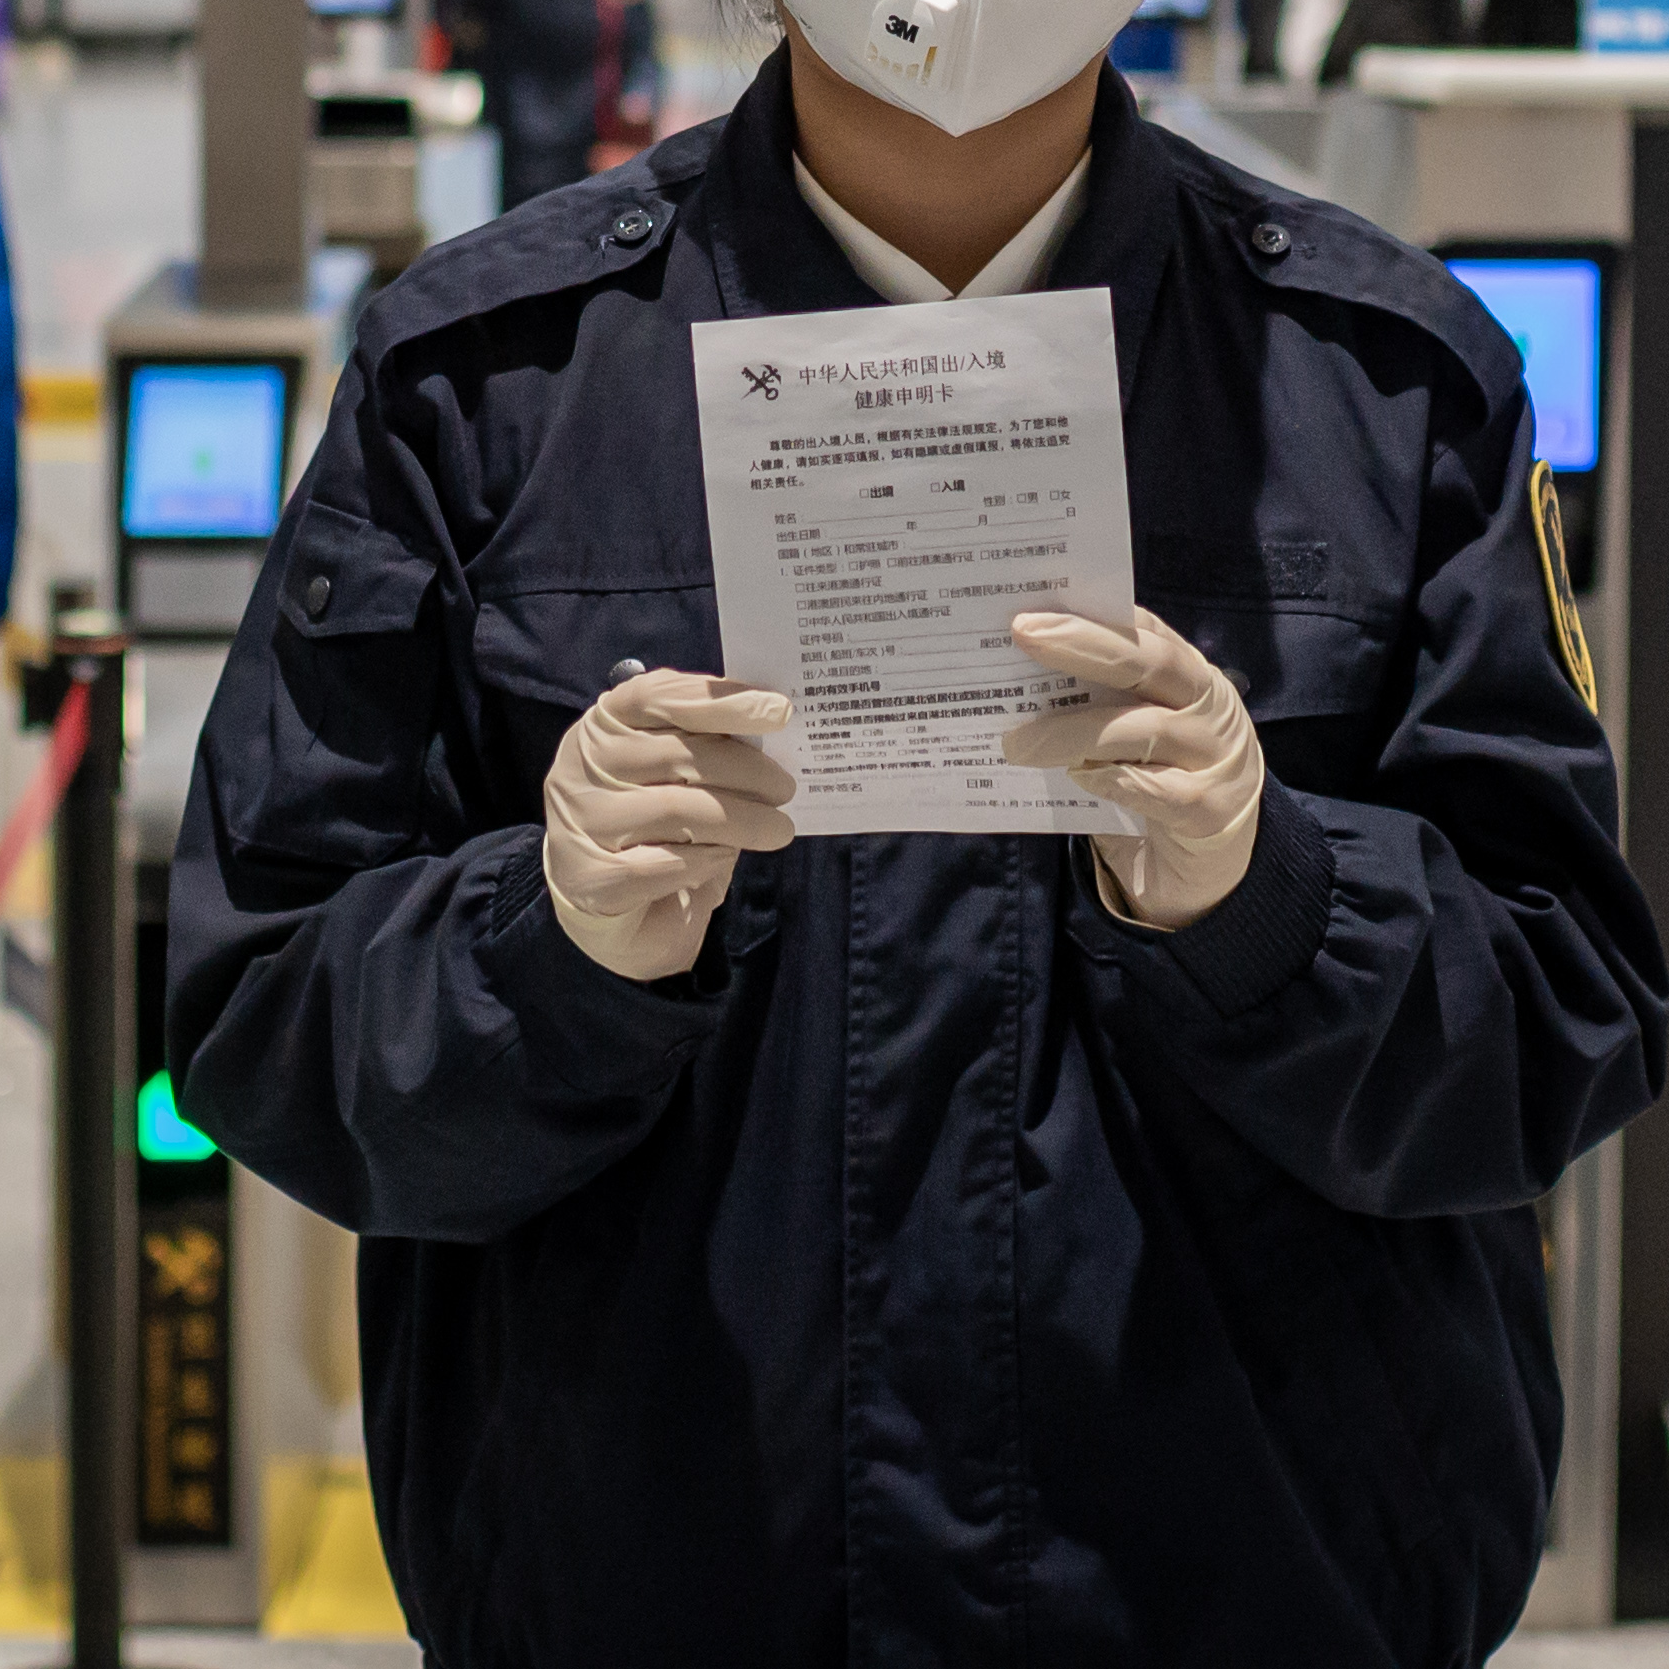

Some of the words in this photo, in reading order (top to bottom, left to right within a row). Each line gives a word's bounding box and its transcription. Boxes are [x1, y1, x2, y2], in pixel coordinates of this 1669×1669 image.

[884, 15, 920, 44] 3M
[798, 349, 1007, 386] 中华人民共和国出/入境
[854, 382, 954, 410] 健康申明卡
[1061, 489, 1071, 501] 女
[978, 514, 988, 527] 月
[1066, 506, 1076, 518] 日
